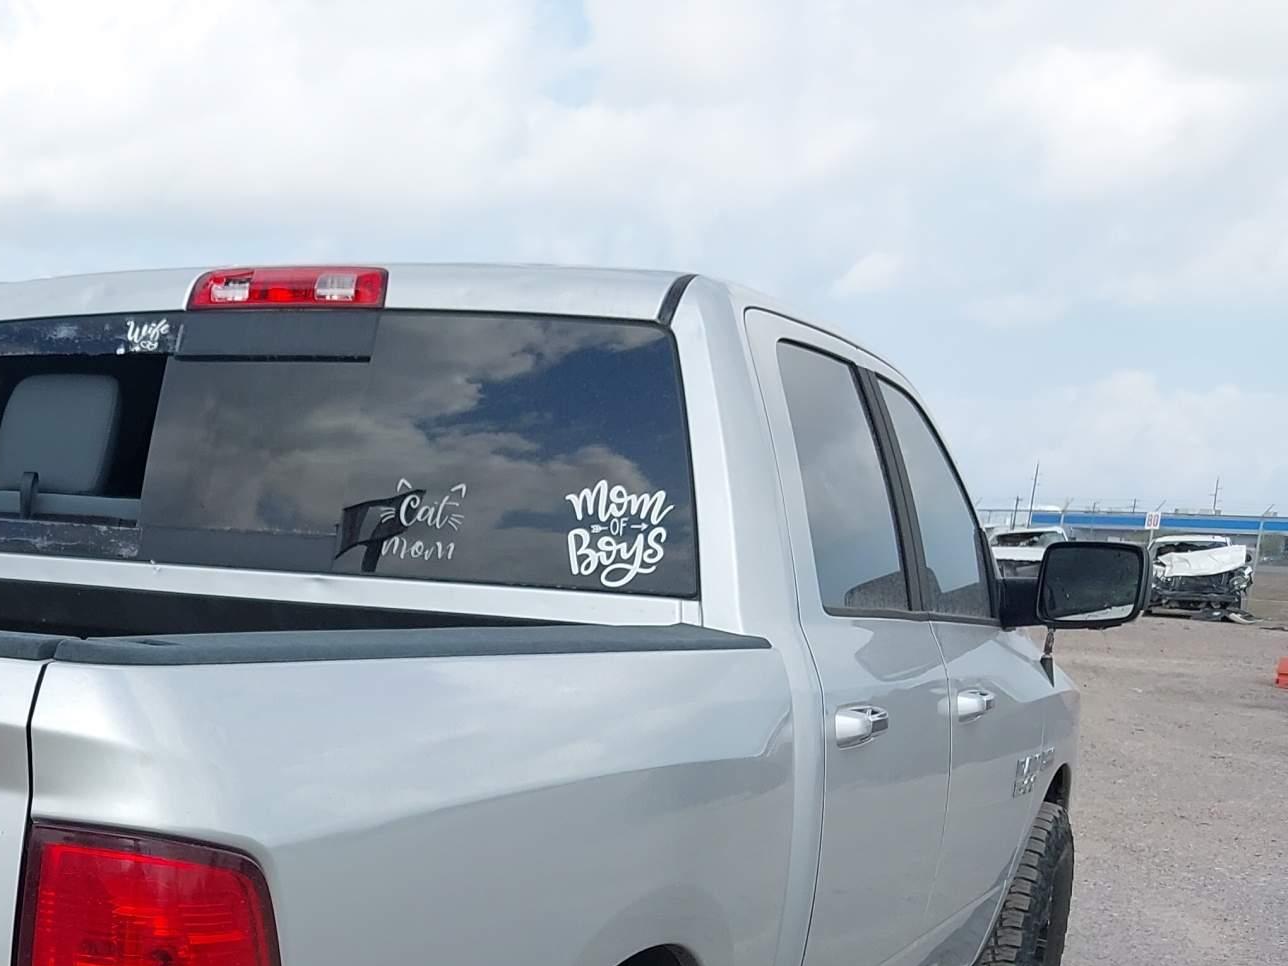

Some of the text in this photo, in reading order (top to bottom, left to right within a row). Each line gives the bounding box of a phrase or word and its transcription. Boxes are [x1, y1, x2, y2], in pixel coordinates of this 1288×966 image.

[399, 494, 460, 529] Cat
[610, 517, 629, 536] OF
[568, 527, 666, 587] Boys
